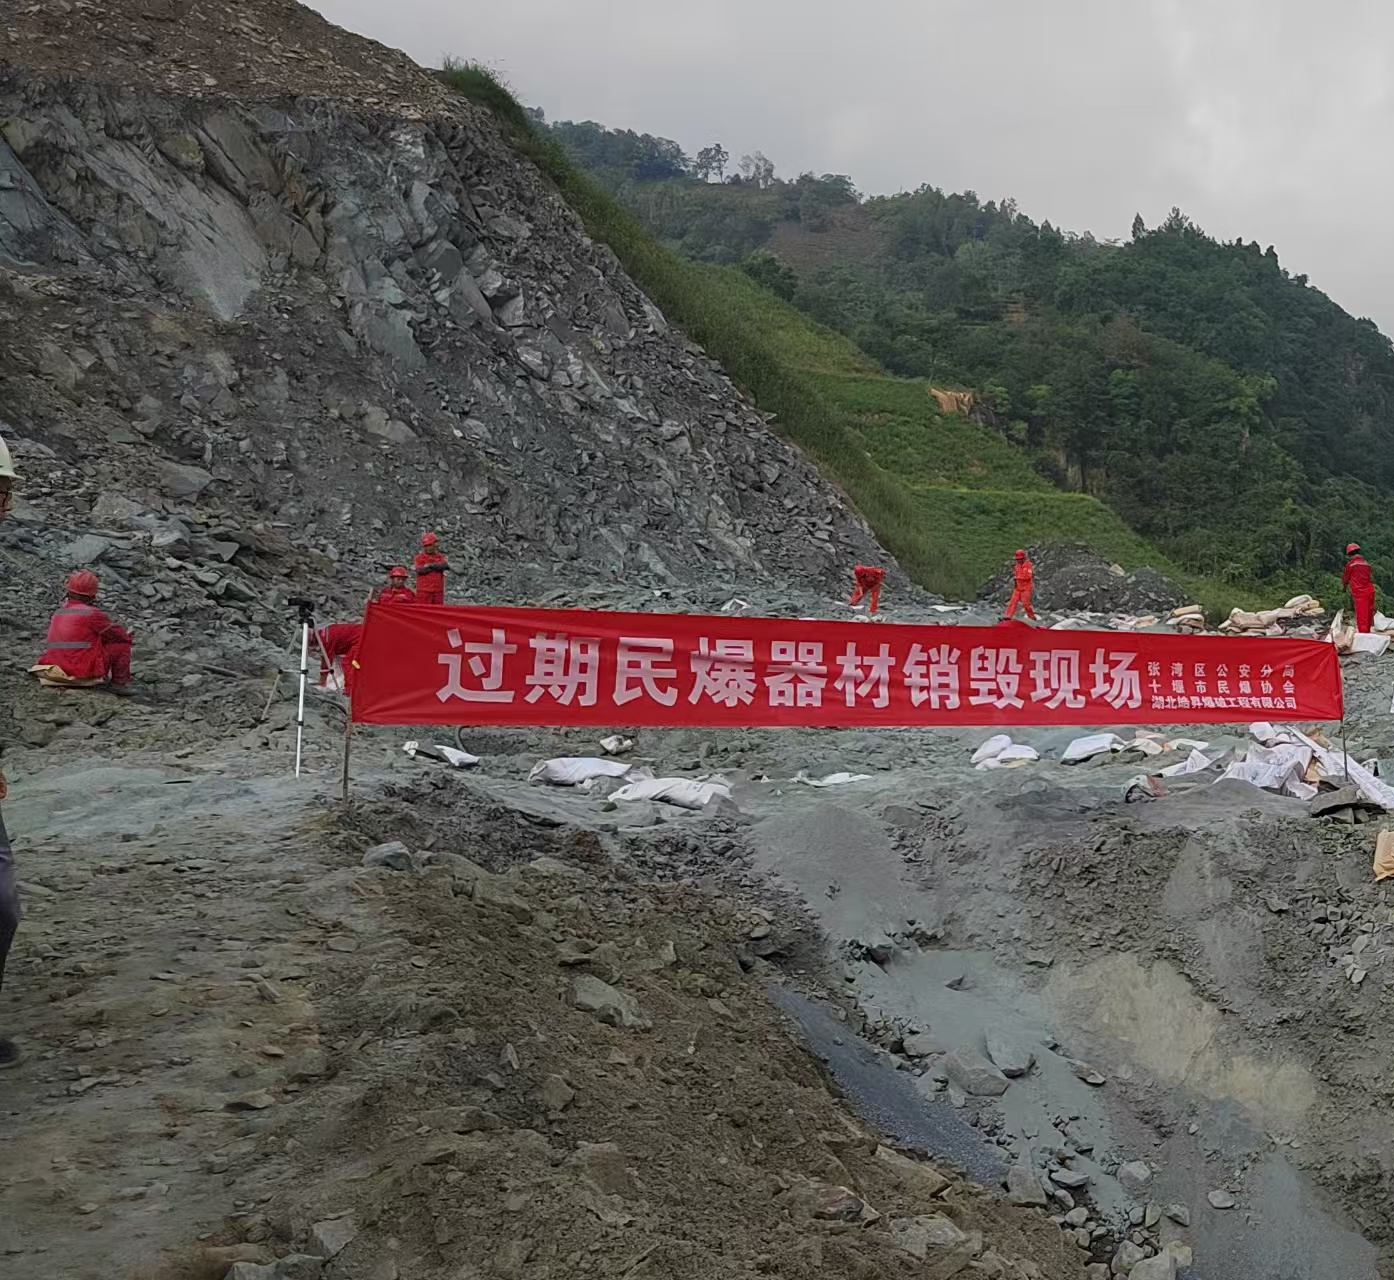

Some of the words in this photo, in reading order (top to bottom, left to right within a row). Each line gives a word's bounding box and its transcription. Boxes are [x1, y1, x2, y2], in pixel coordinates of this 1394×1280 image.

[436, 627, 1142, 711] 过期民爆器材销毁现场
[1147, 661, 1295, 678] 张湾区公安分局
[1147, 679, 1295, 694] 十堰市民爆协会
